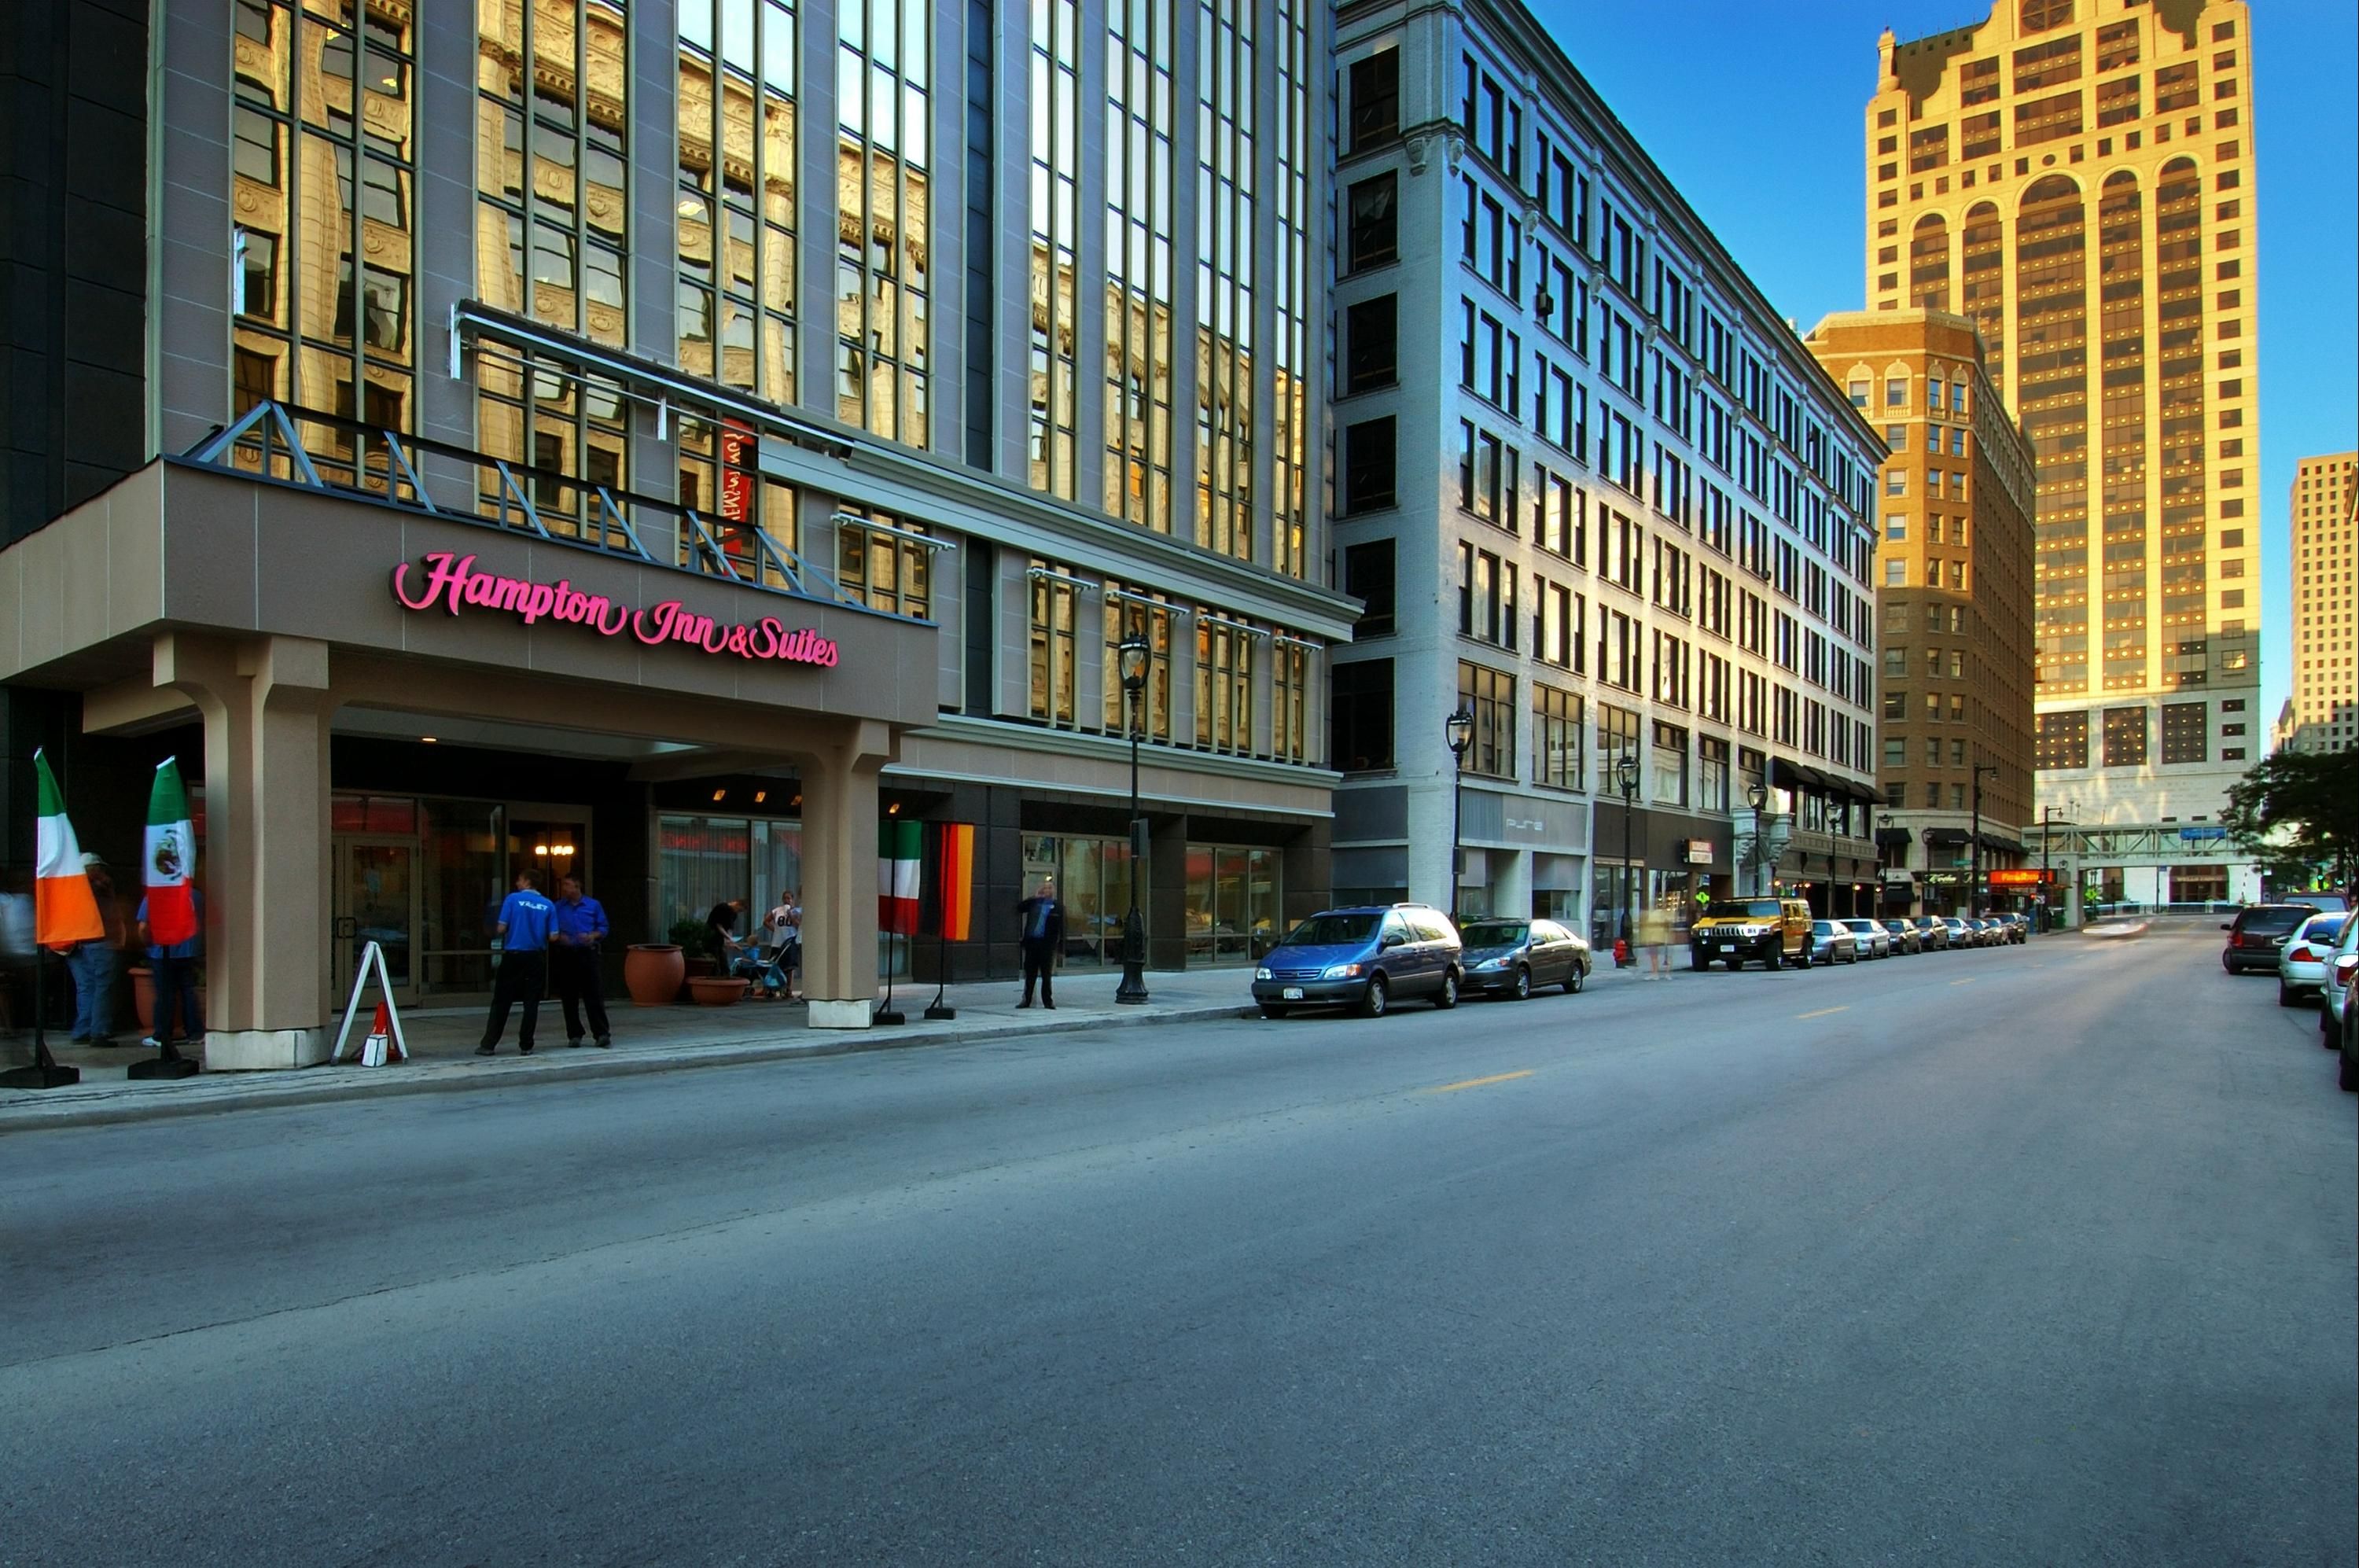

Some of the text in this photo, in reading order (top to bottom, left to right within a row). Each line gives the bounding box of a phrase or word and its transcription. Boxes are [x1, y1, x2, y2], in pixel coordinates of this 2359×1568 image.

[395, 553, 839, 668] Hampton Inn & Suites
